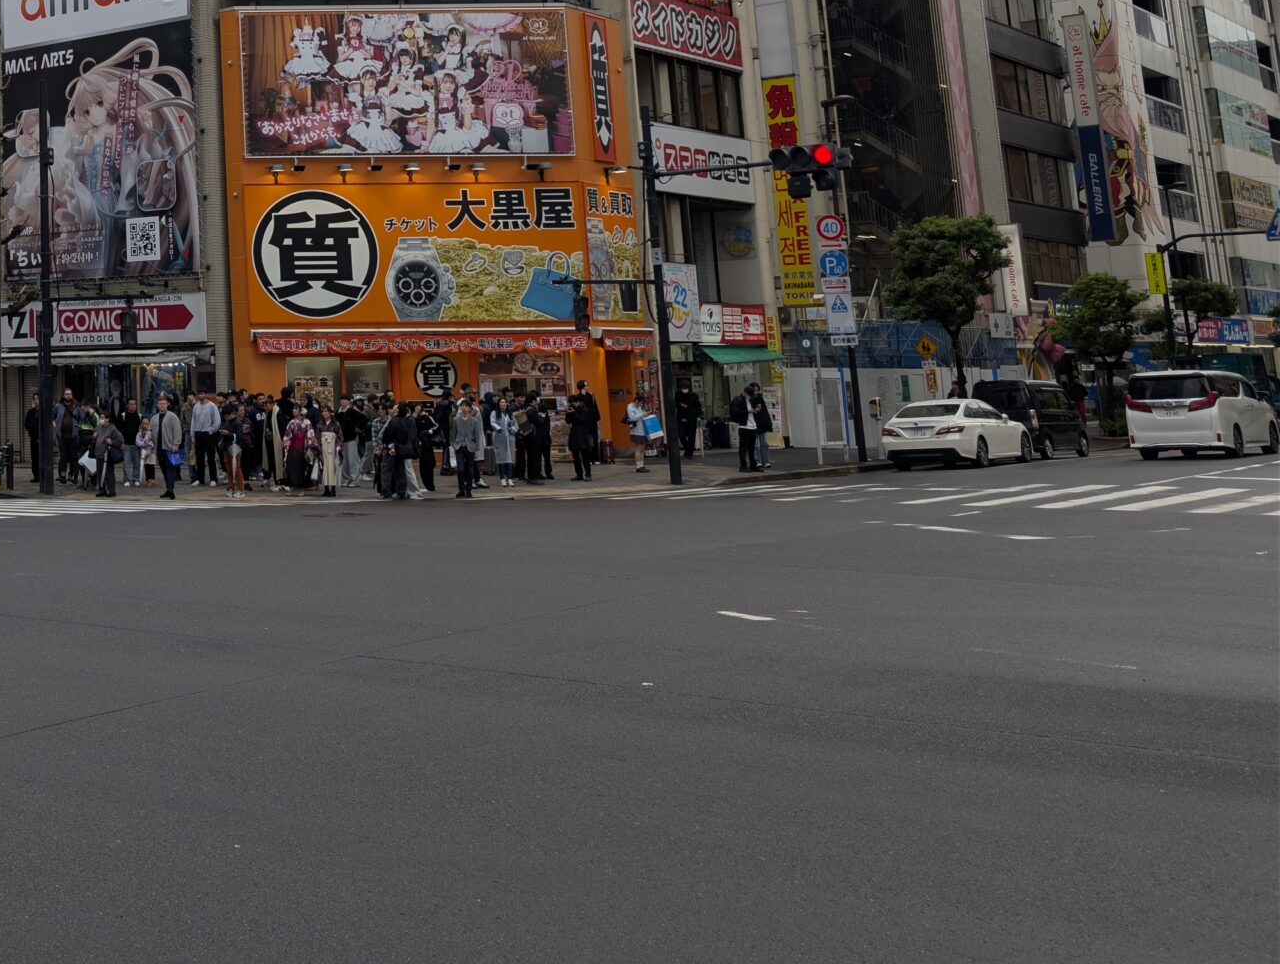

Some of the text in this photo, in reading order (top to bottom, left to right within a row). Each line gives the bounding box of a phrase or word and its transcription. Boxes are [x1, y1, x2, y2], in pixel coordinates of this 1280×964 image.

[40, 48, 74, 70] ARTS
[1072, 45, 1090, 117] at-home cafe
[663, 143, 751, 185] スマホ修理王
[1087, 152, 1105, 215] GALLERIA
[384, 186, 577, 233] チケット 大黒屋
[822, 221, 838, 233] 40
[794, 211, 812, 266] FREE
[268, 208, 368, 302] 質
[825, 257, 837, 274] P
[784, 282, 815, 290] AKIHABARA
[785, 292, 815, 300] TOKIS
[701, 321, 721, 333] TOKIS
[59, 333, 114, 344] Akihabara
[258, 336, 588, 352] 高価買取 無料査定
[420, 359, 454, 391] 質
